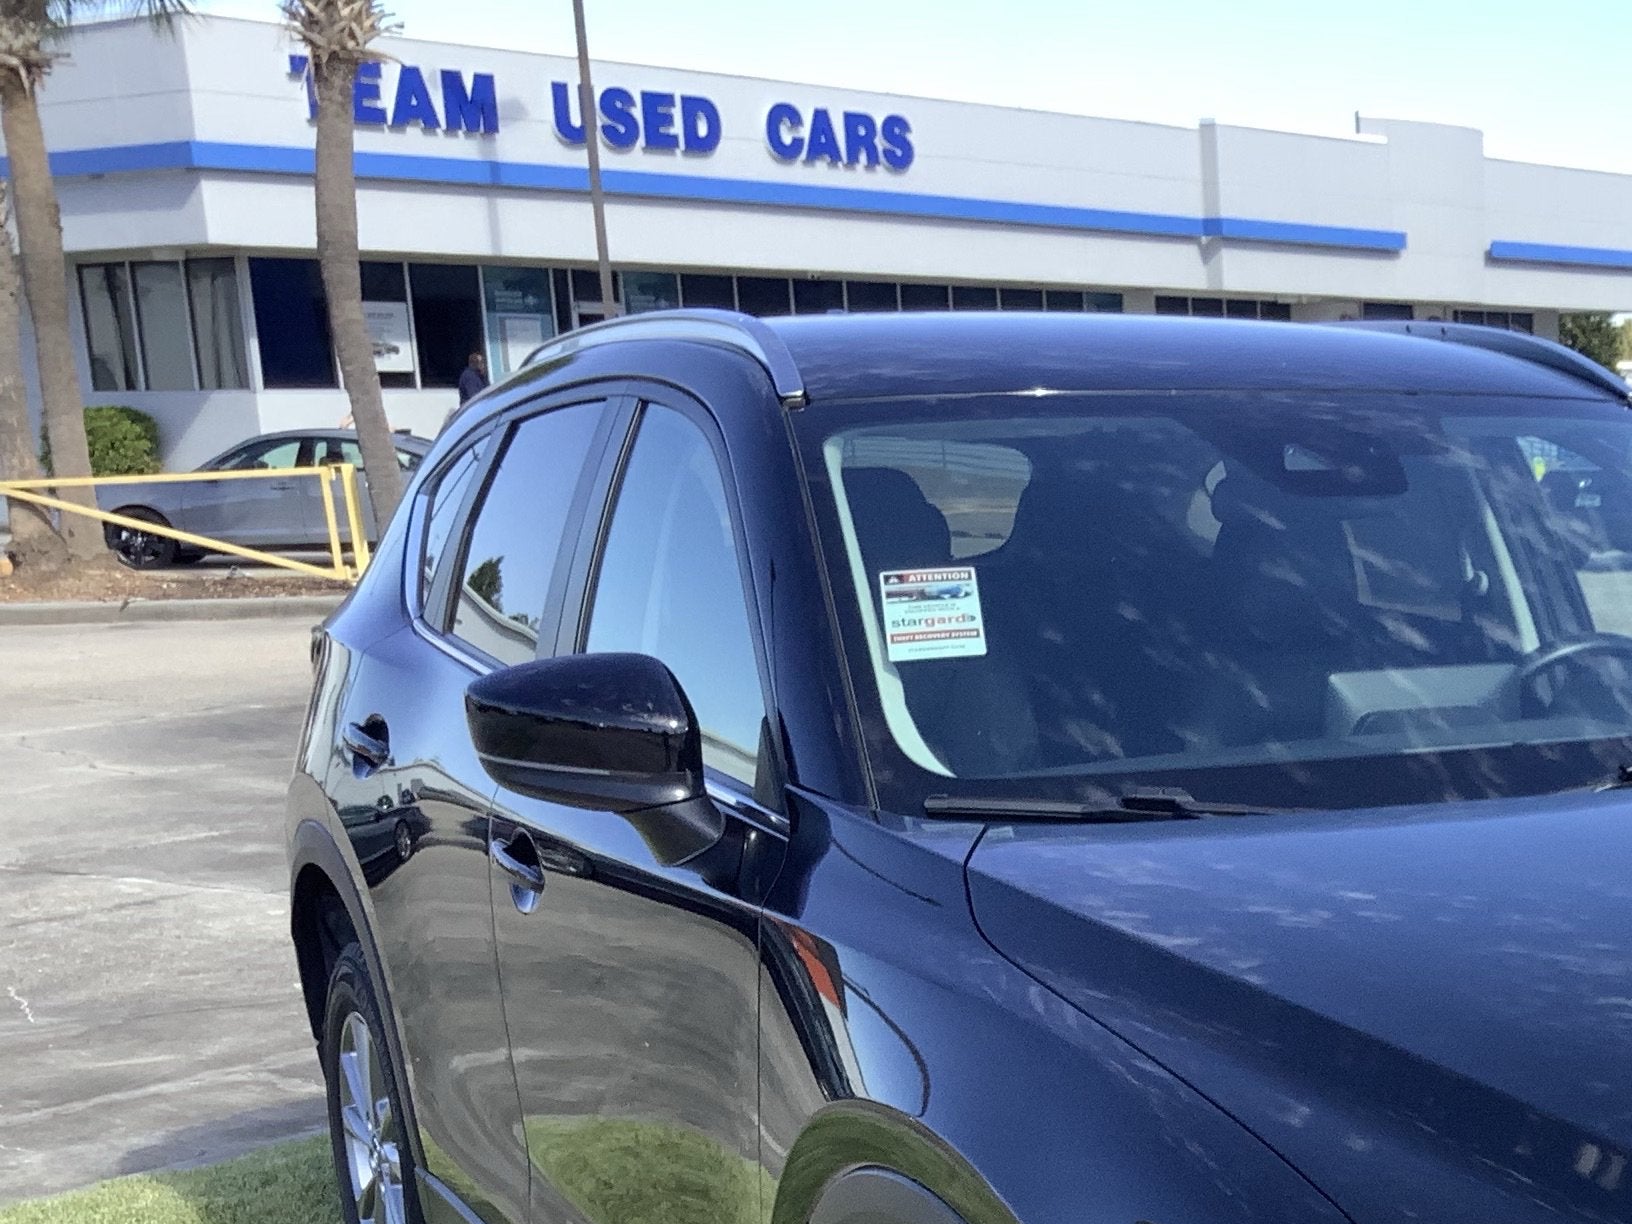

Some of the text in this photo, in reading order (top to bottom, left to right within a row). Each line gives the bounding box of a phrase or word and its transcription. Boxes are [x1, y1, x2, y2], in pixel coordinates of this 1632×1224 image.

[551, 81, 722, 154] USED
[766, 103, 914, 171] CARS
[909, 572, 969, 582] ATTENTION
[892, 614, 967, 628] stargard
